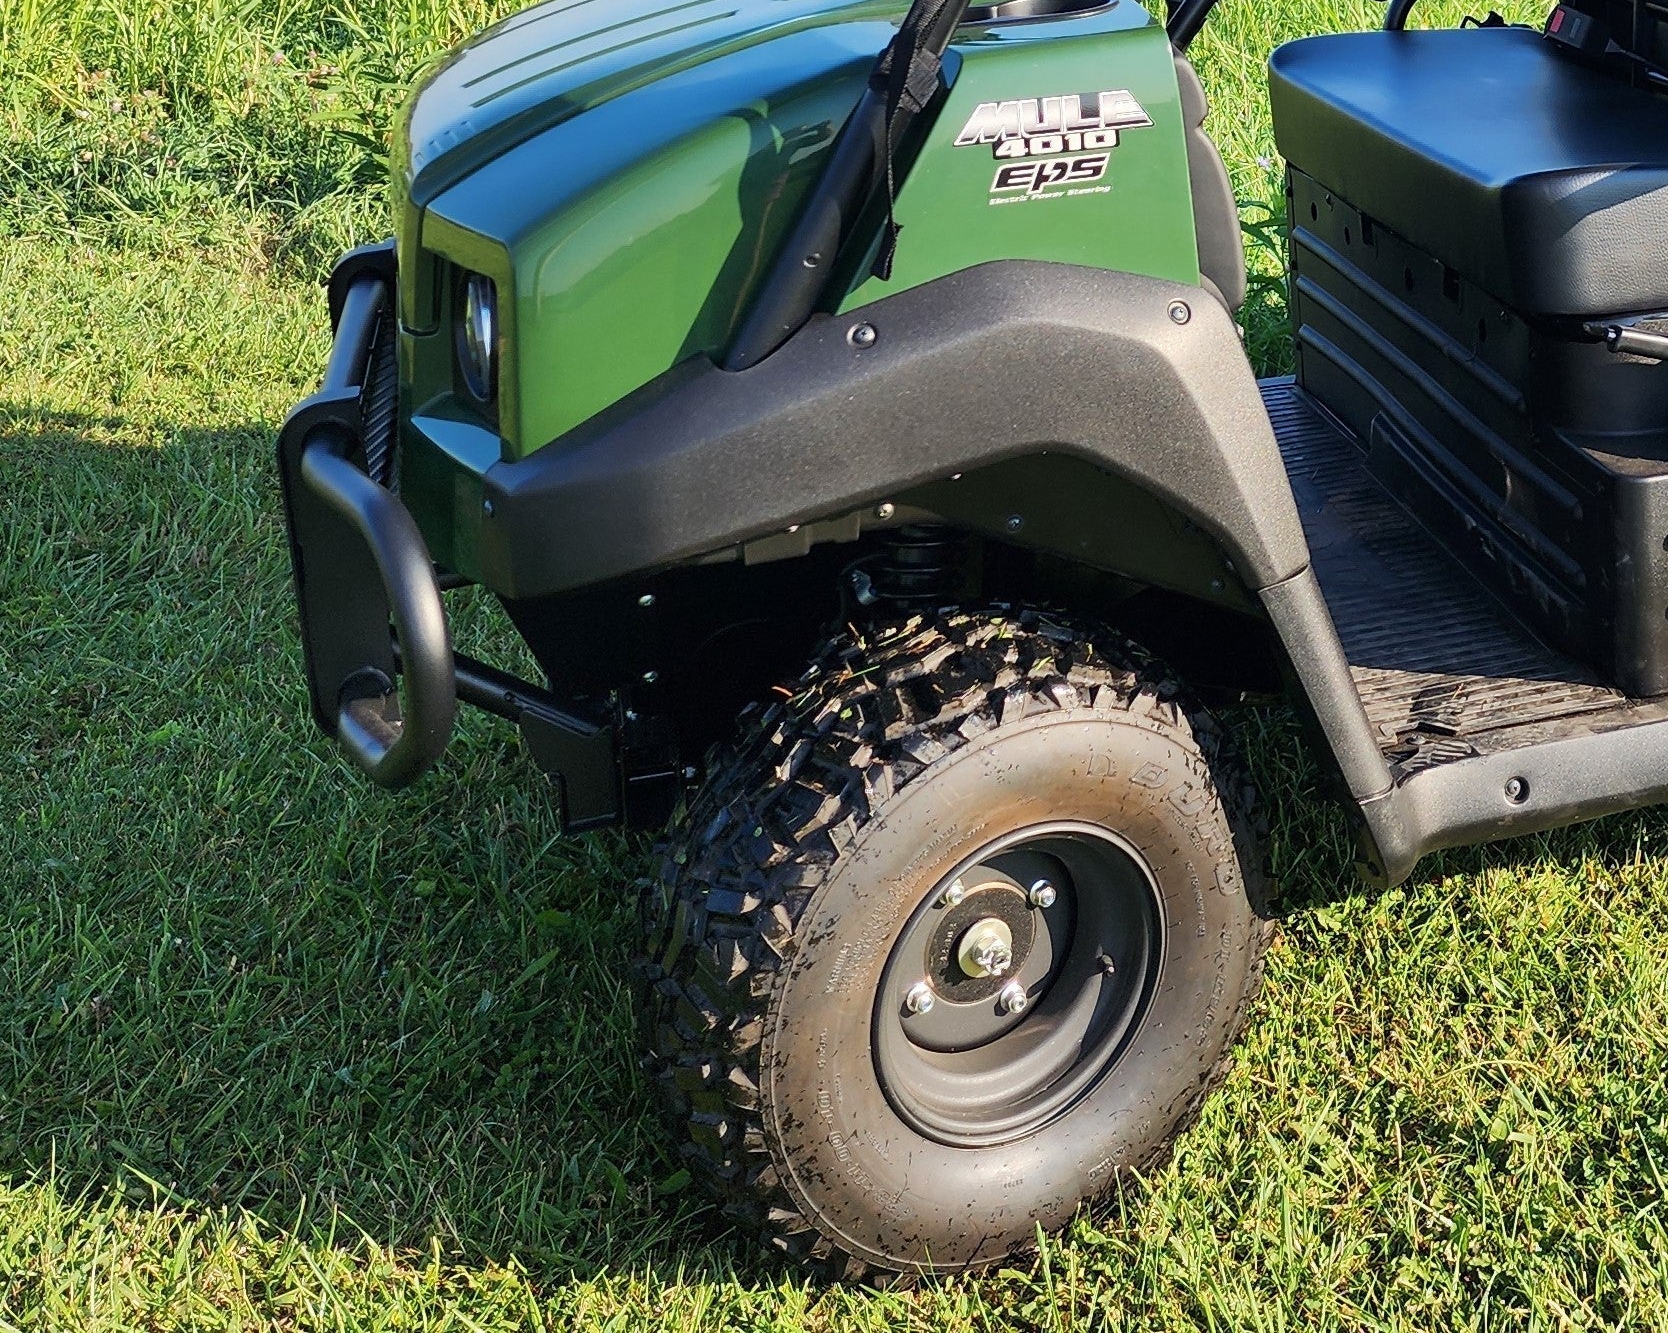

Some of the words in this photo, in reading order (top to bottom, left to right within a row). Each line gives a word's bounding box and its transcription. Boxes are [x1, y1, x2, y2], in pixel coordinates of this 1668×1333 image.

[953, 89, 1155, 147] MULE
[995, 129, 1118, 158] 4010
[989, 152, 1111, 195] EPS
[1129, 761, 1243, 897] DURO
